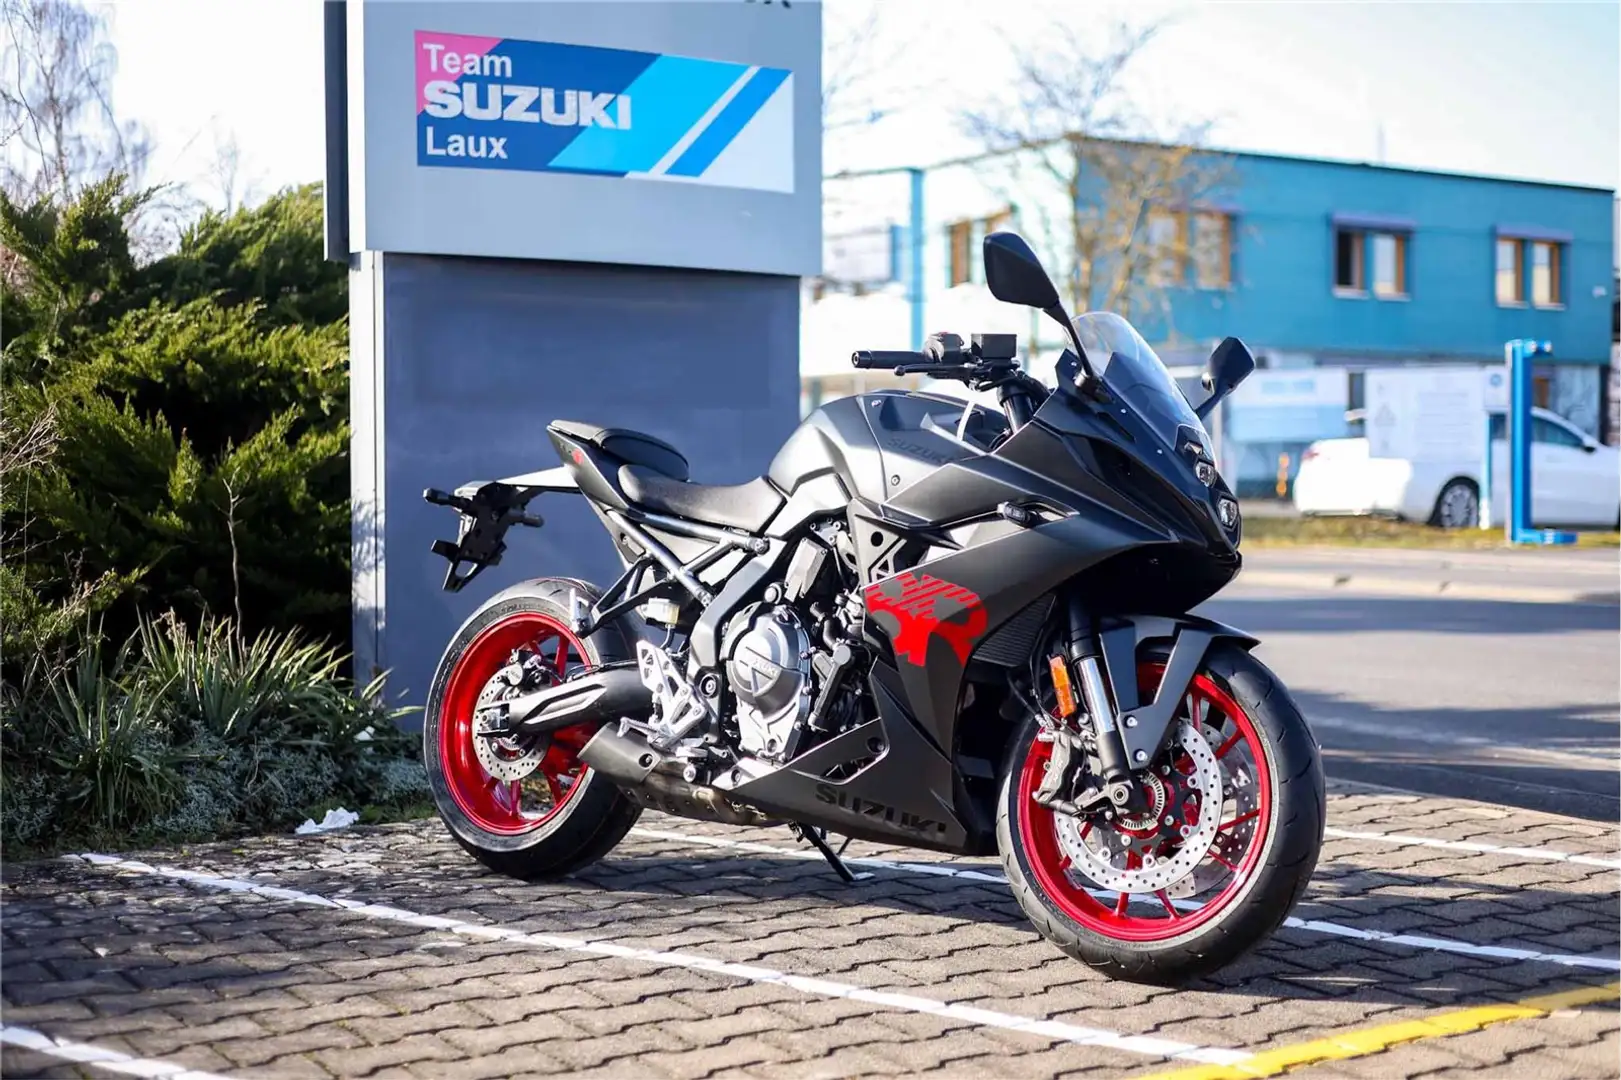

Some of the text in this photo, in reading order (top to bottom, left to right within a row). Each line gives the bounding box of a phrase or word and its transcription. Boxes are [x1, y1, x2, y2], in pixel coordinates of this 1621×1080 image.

[422, 43, 513, 78] Team
[423, 80, 632, 130] SUZUKI
[426, 126, 508, 159] Laux
[814, 783, 948, 841] SUZUKI
